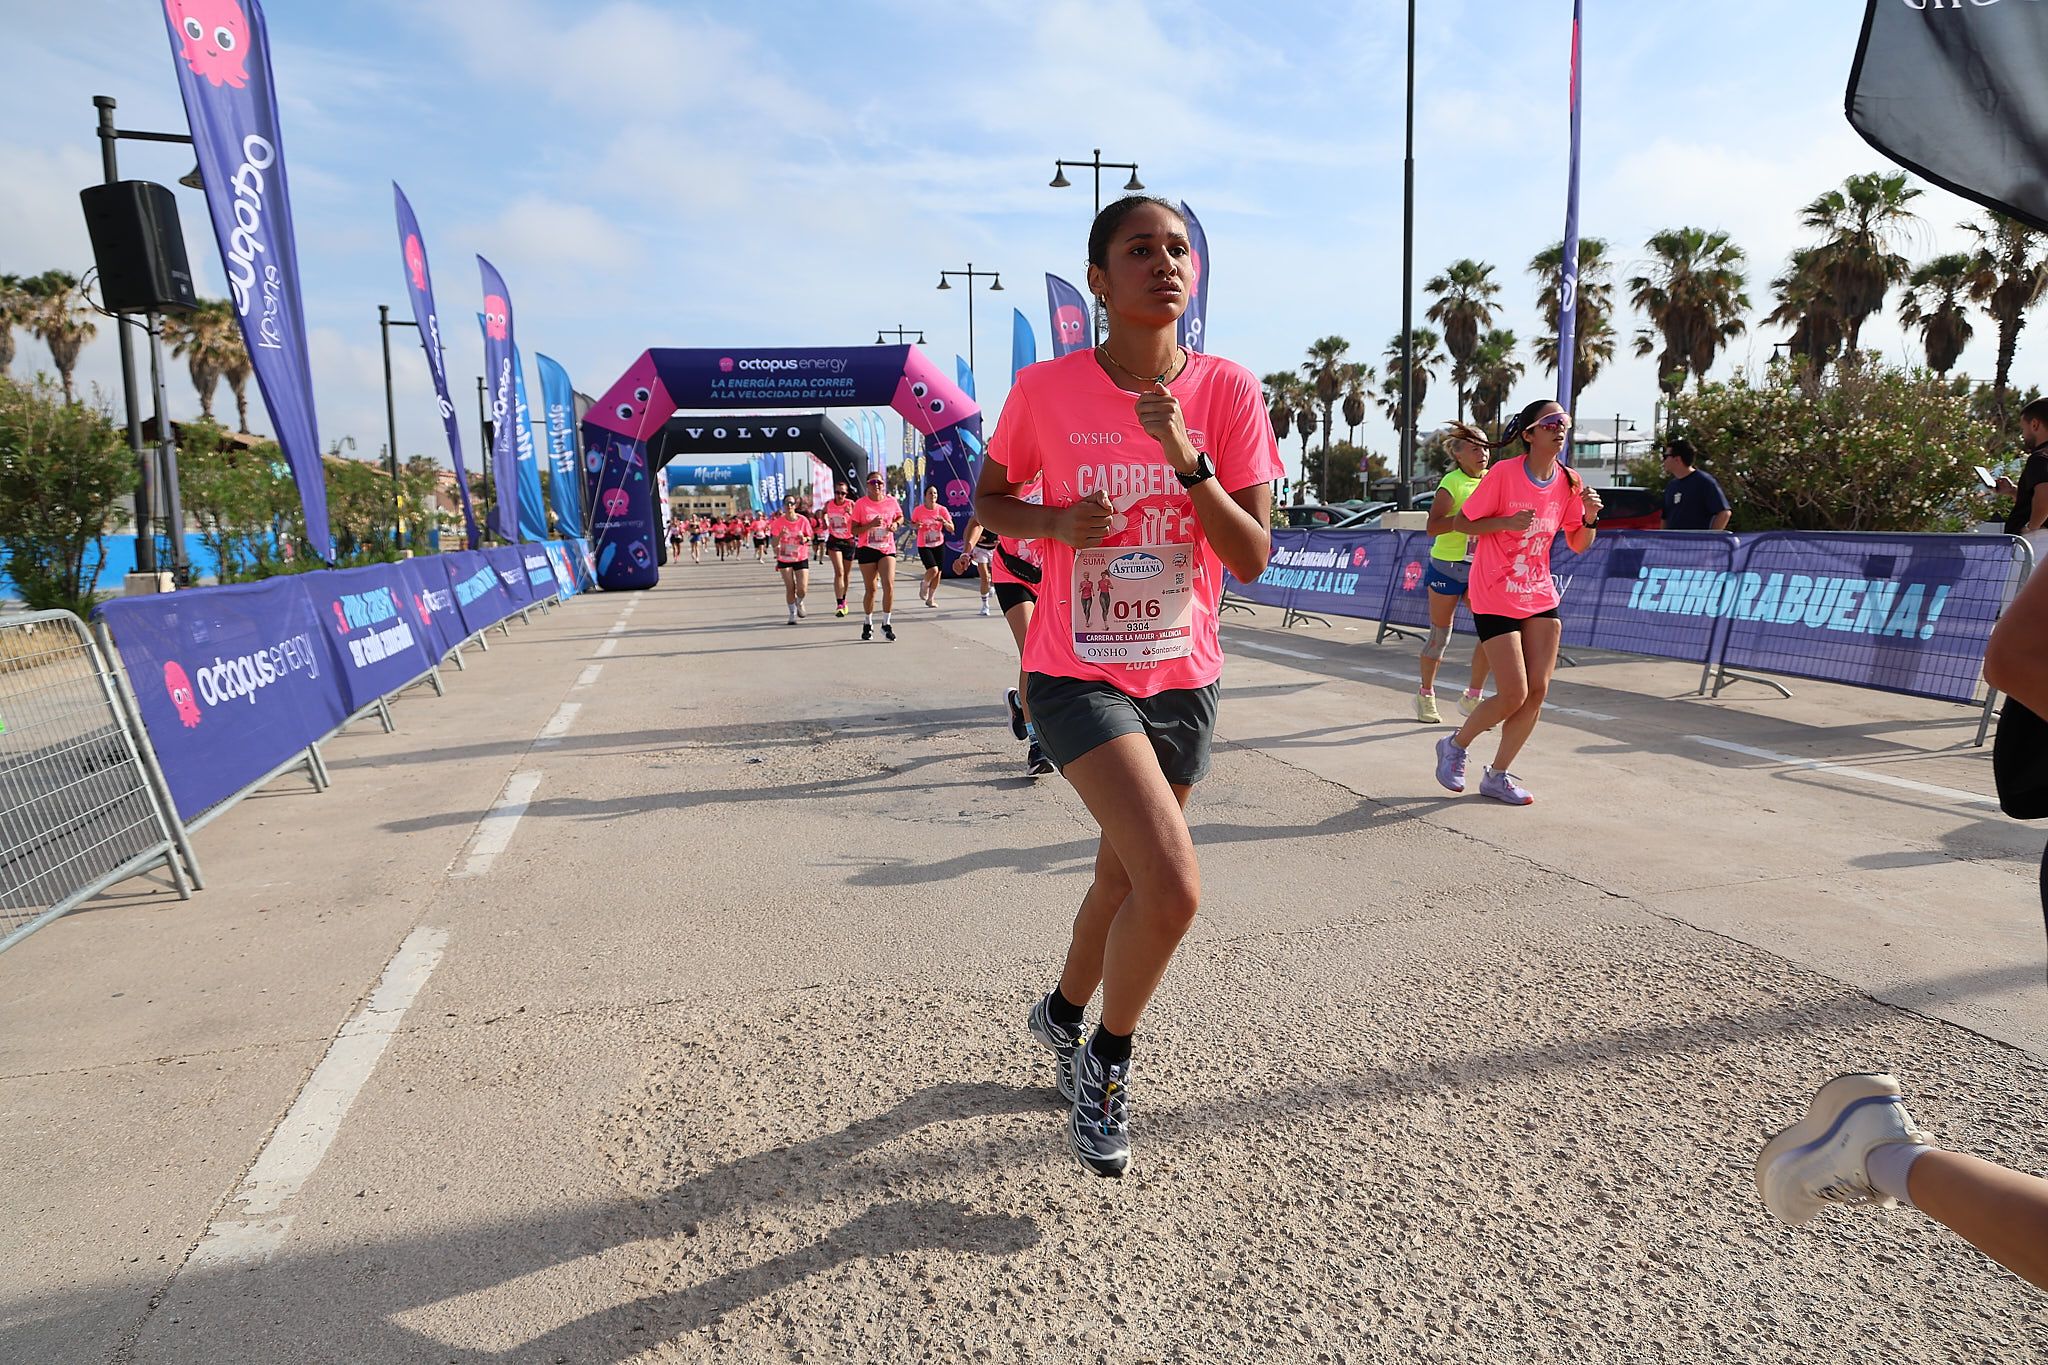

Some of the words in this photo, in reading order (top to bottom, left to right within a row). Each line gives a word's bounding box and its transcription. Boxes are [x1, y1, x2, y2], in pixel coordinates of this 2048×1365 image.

[739, 358, 798, 372] octopus
[799, 358, 848, 373] energy
[711, 379, 726, 388] LA
[728, 377, 775, 388] ENERGÍA
[777, 378, 808, 387] PARA
[810, 378, 854, 387] CORRER
[710, 390, 719, 398] A
[721, 390, 735, 398] LA
[738, 390, 800, 398] VELOCIDAD
[802, 390, 816, 398] DE
[818, 389, 833, 398] LA
[834, 389, 856, 397] LUZ
[685, 427, 801, 439] VOLVO
[1069, 432, 1122, 444] OYSHO
[1078, 464, 1189, 498] CARRER
[1141, 507, 1179, 545] DE
[1083, 558, 1106, 566] SUMA
[1113, 563, 1160, 574] ASTURIANA
[1316, 571, 1334, 592] LA
[1334, 573, 1359, 595] LUZ
[1114, 599, 1161, 620] 016
[1127, 622, 1150, 631] 9304
[1086, 634, 1114, 642] CARRERA
[1135, 632, 1155, 640] MUJER
[1159, 629, 1182, 638] VALENCIA
[1087, 648, 1128, 657] OYSHO
[1151, 646, 1182, 655] Santander
[197, 650, 276, 706] octopus
[269, 632, 320, 680] energy
